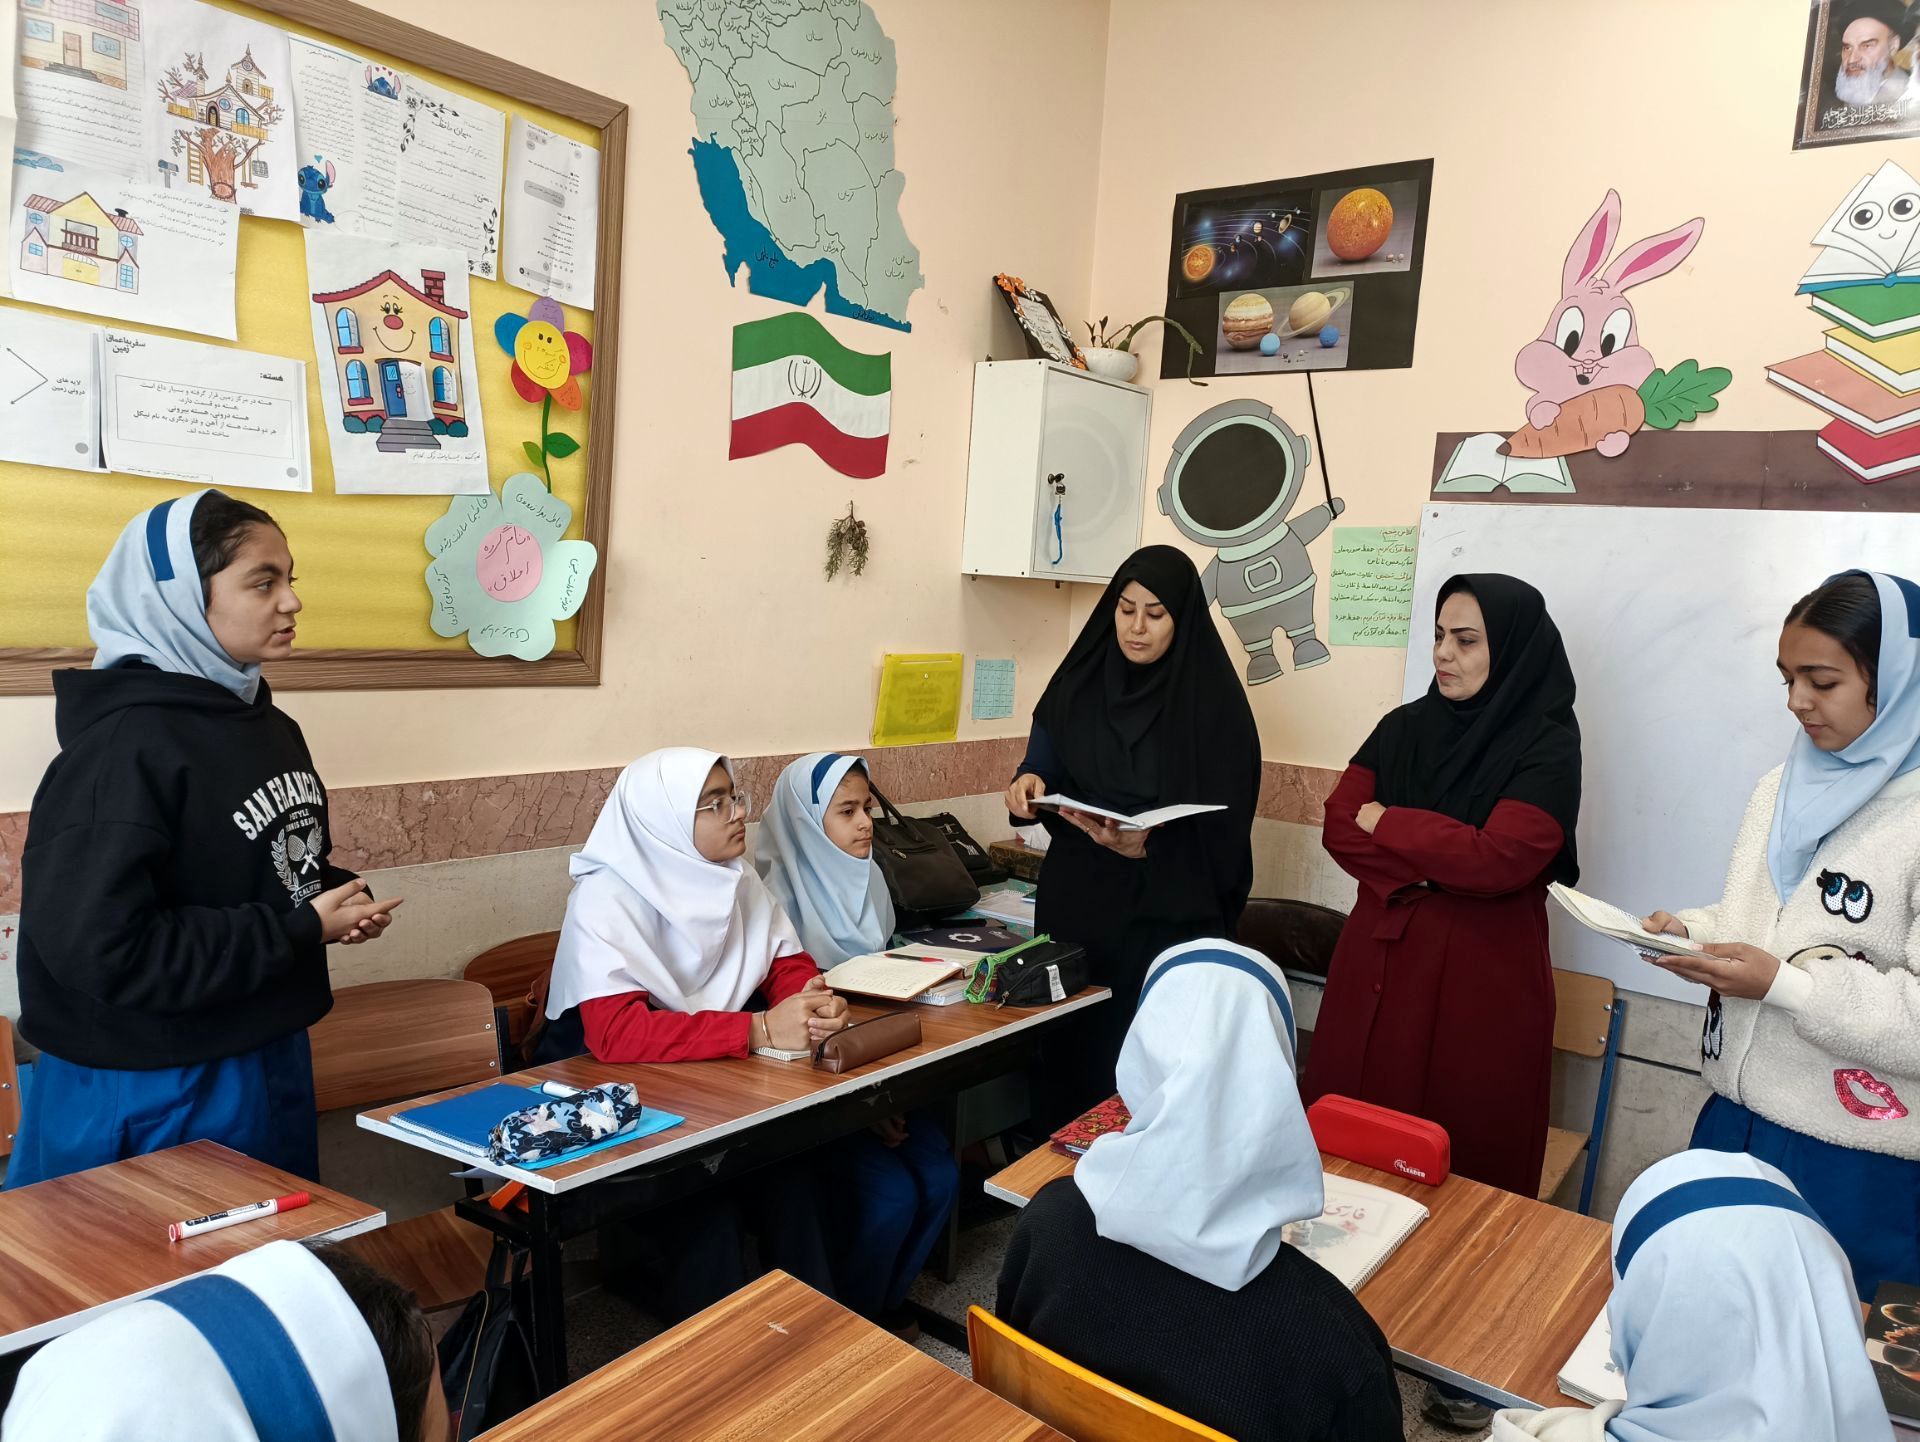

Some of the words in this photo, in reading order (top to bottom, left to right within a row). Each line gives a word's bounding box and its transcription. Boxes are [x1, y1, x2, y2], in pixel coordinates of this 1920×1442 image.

[112, 344, 130, 354] زمین
[260, 371, 284, 382] هسته:
[67, 387, 86, 396] درونی
[232, 787, 277, 841] SAN
[1323, 1204, 1367, 1221] فارسی
